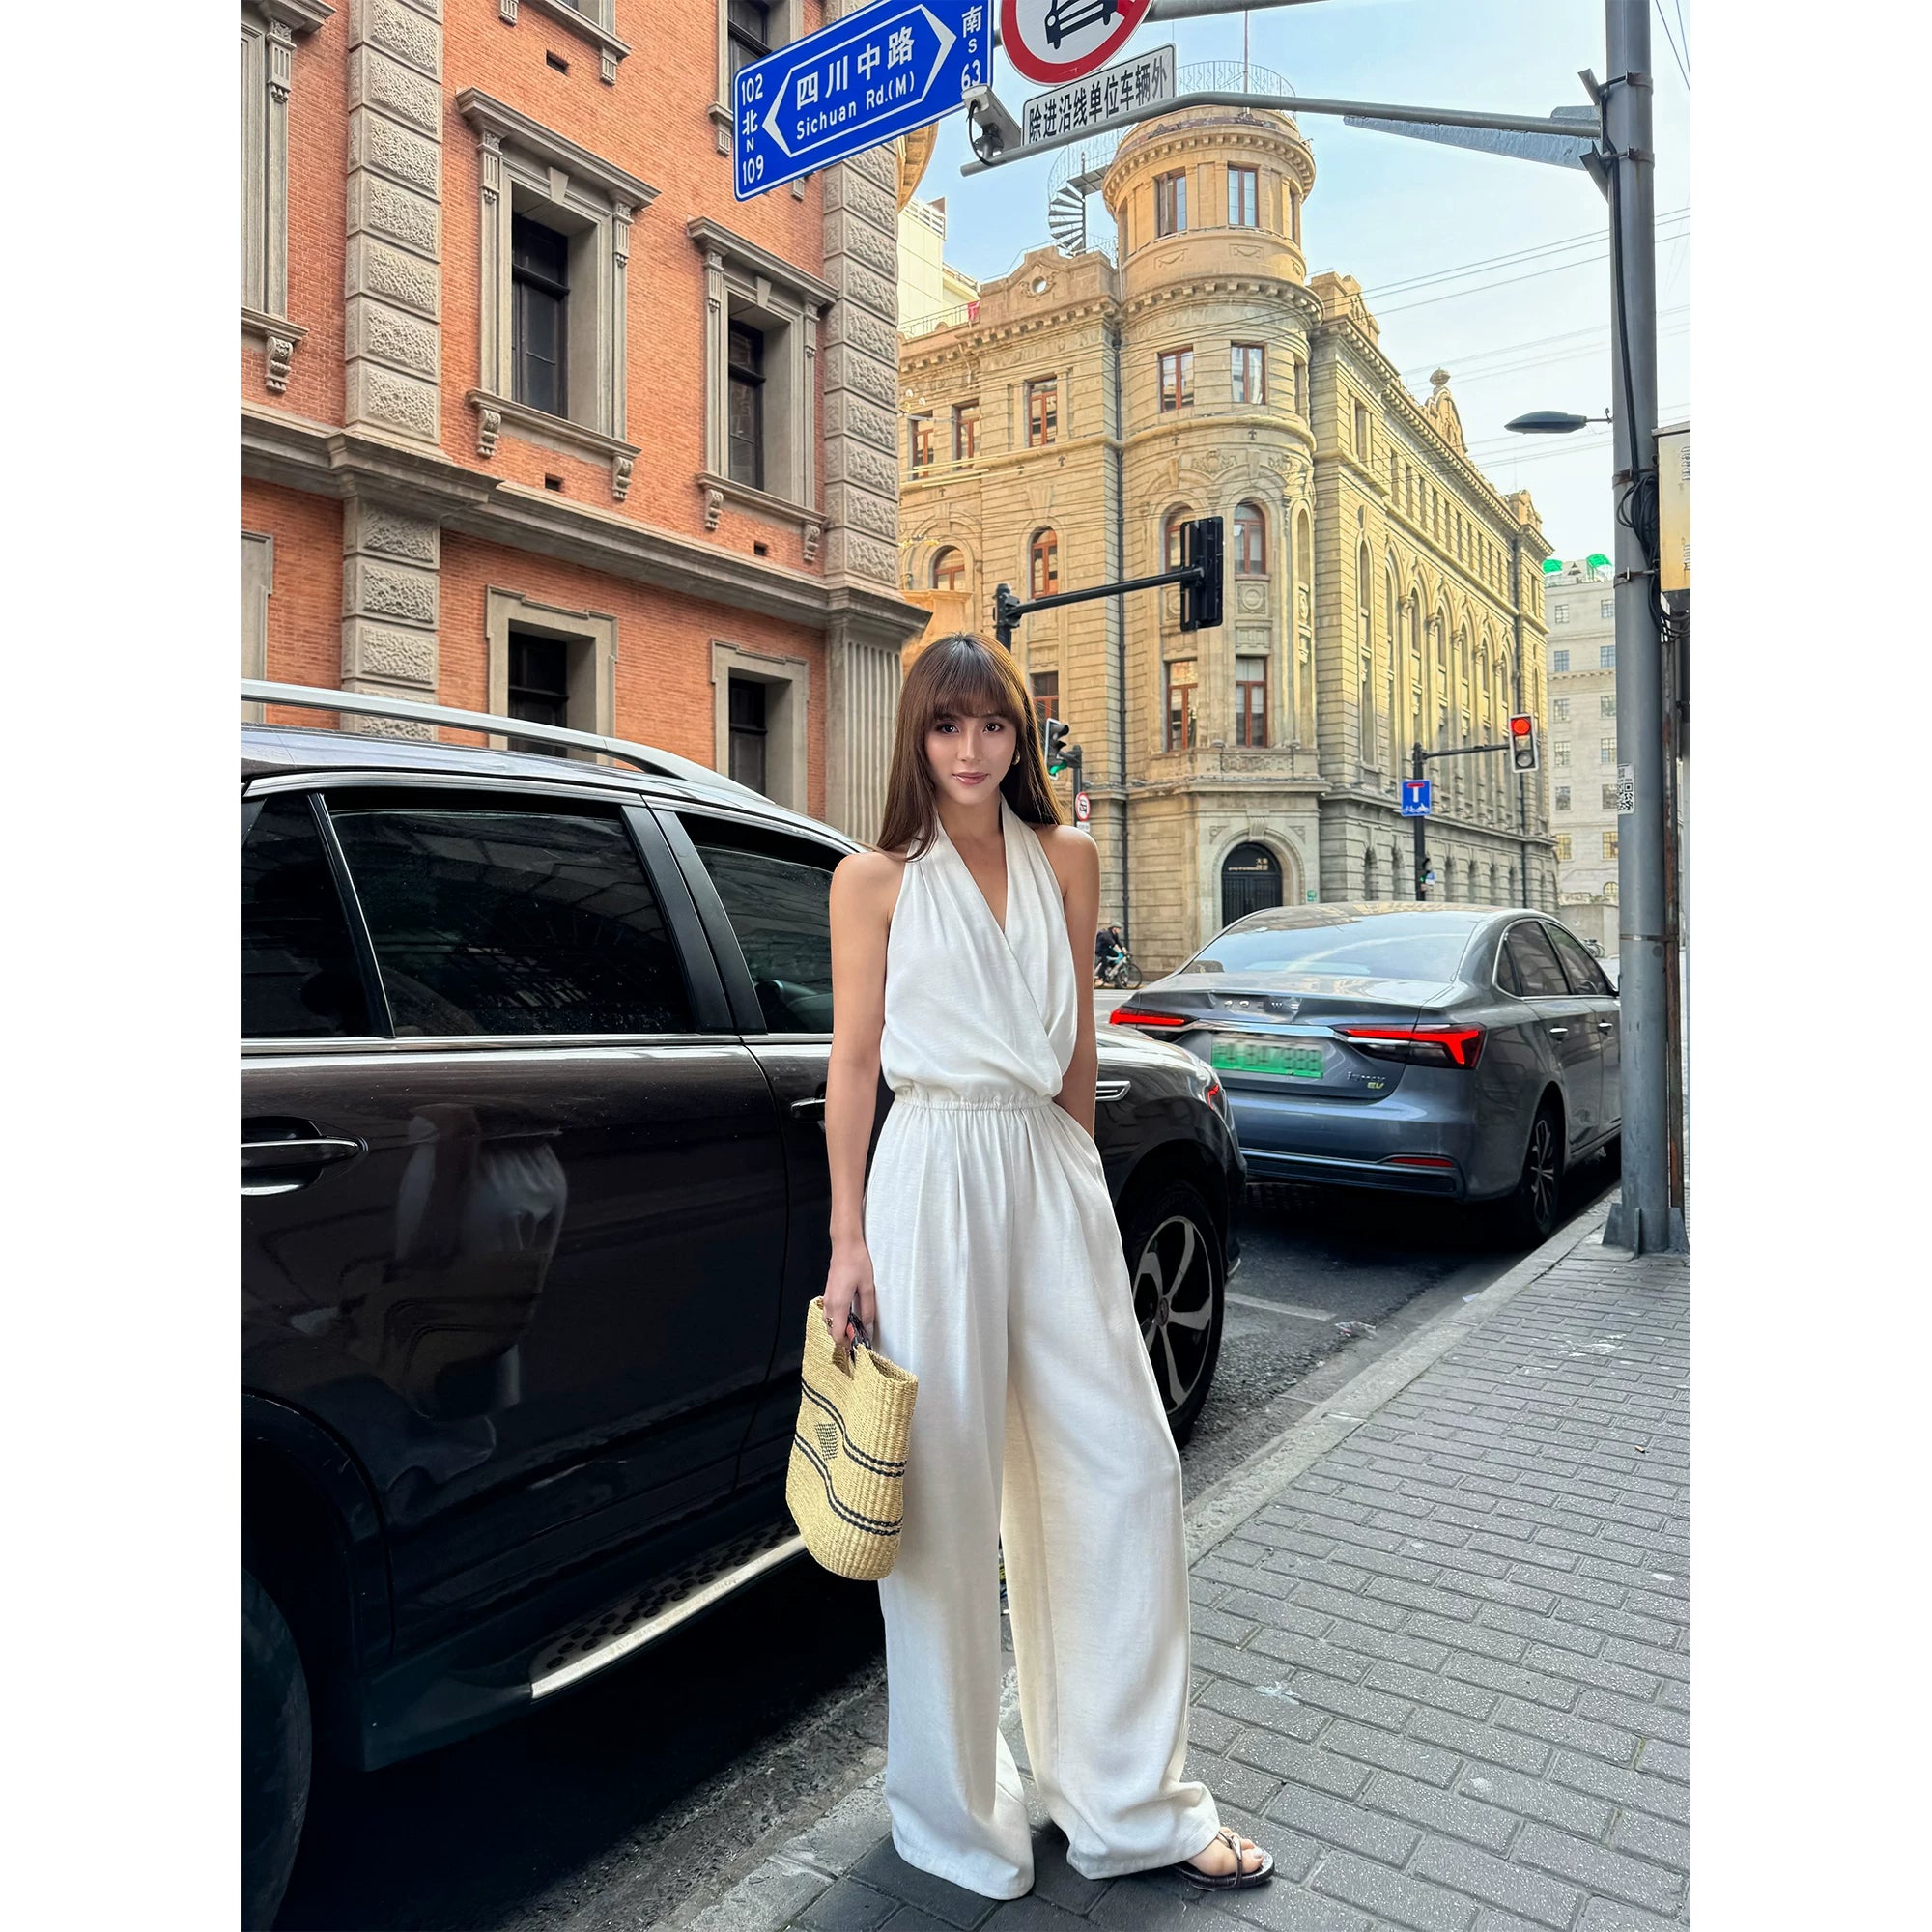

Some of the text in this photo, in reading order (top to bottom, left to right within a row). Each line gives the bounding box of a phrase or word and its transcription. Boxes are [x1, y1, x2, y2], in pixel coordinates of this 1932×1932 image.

[961, 5, 983, 38] 南
[968, 38, 978, 54] S
[796, 25, 915, 111] 四川中路
[960, 59, 981, 91] 63
[741, 73, 764, 106] 102
[796, 71, 916, 140] Sichuan Rd.(M)
[1028, 55, 1168, 144] 除进沿线单位车辆外
[741, 109, 758, 136] 北
[746, 138, 754, 153] N
[742, 155, 764, 186] 109
